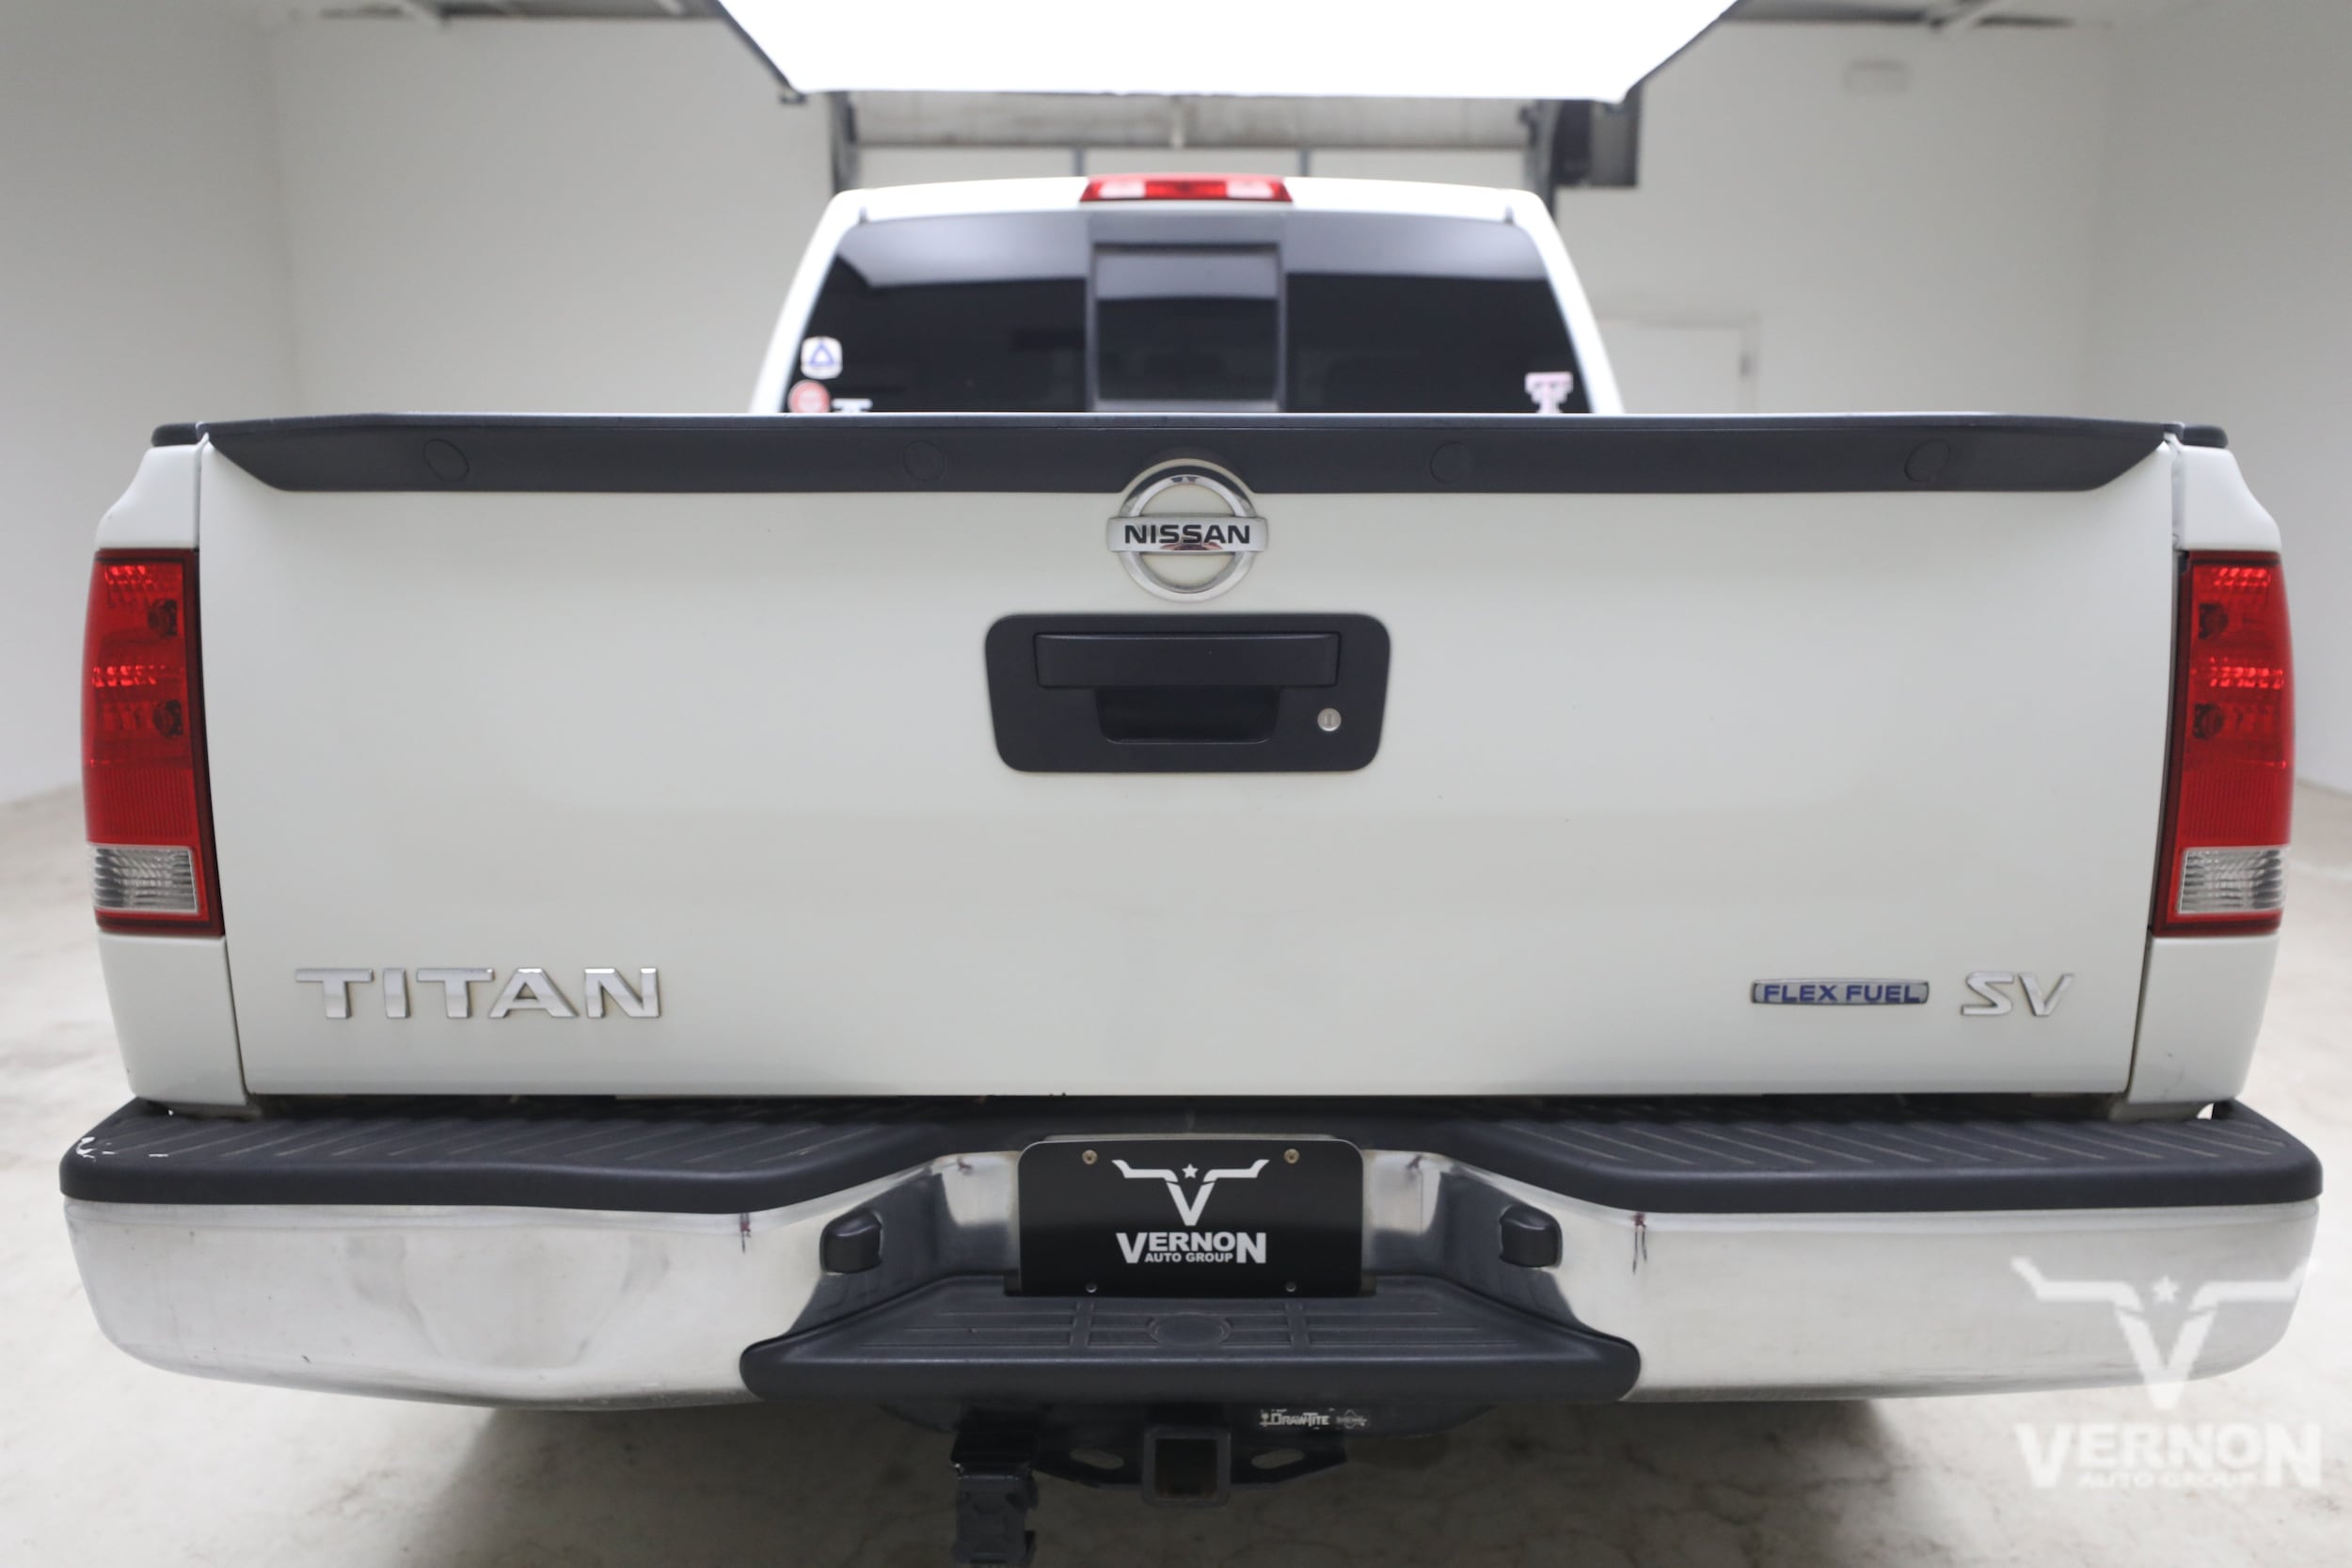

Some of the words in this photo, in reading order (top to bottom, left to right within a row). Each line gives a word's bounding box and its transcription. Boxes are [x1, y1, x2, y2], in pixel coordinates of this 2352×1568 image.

[1124, 525, 1250, 544] NISSAN
[294, 968, 660, 1019] TITAN
[1764, 985, 1837, 1003] FLEX
[1845, 985, 1920, 1004] FUEL
[1961, 971, 2074, 1017] SV
[1116, 1232, 1266, 1263] VERNON
[1144, 1253, 1182, 1262] AUTO
[1185, 1253, 1233, 1262] GROUP
